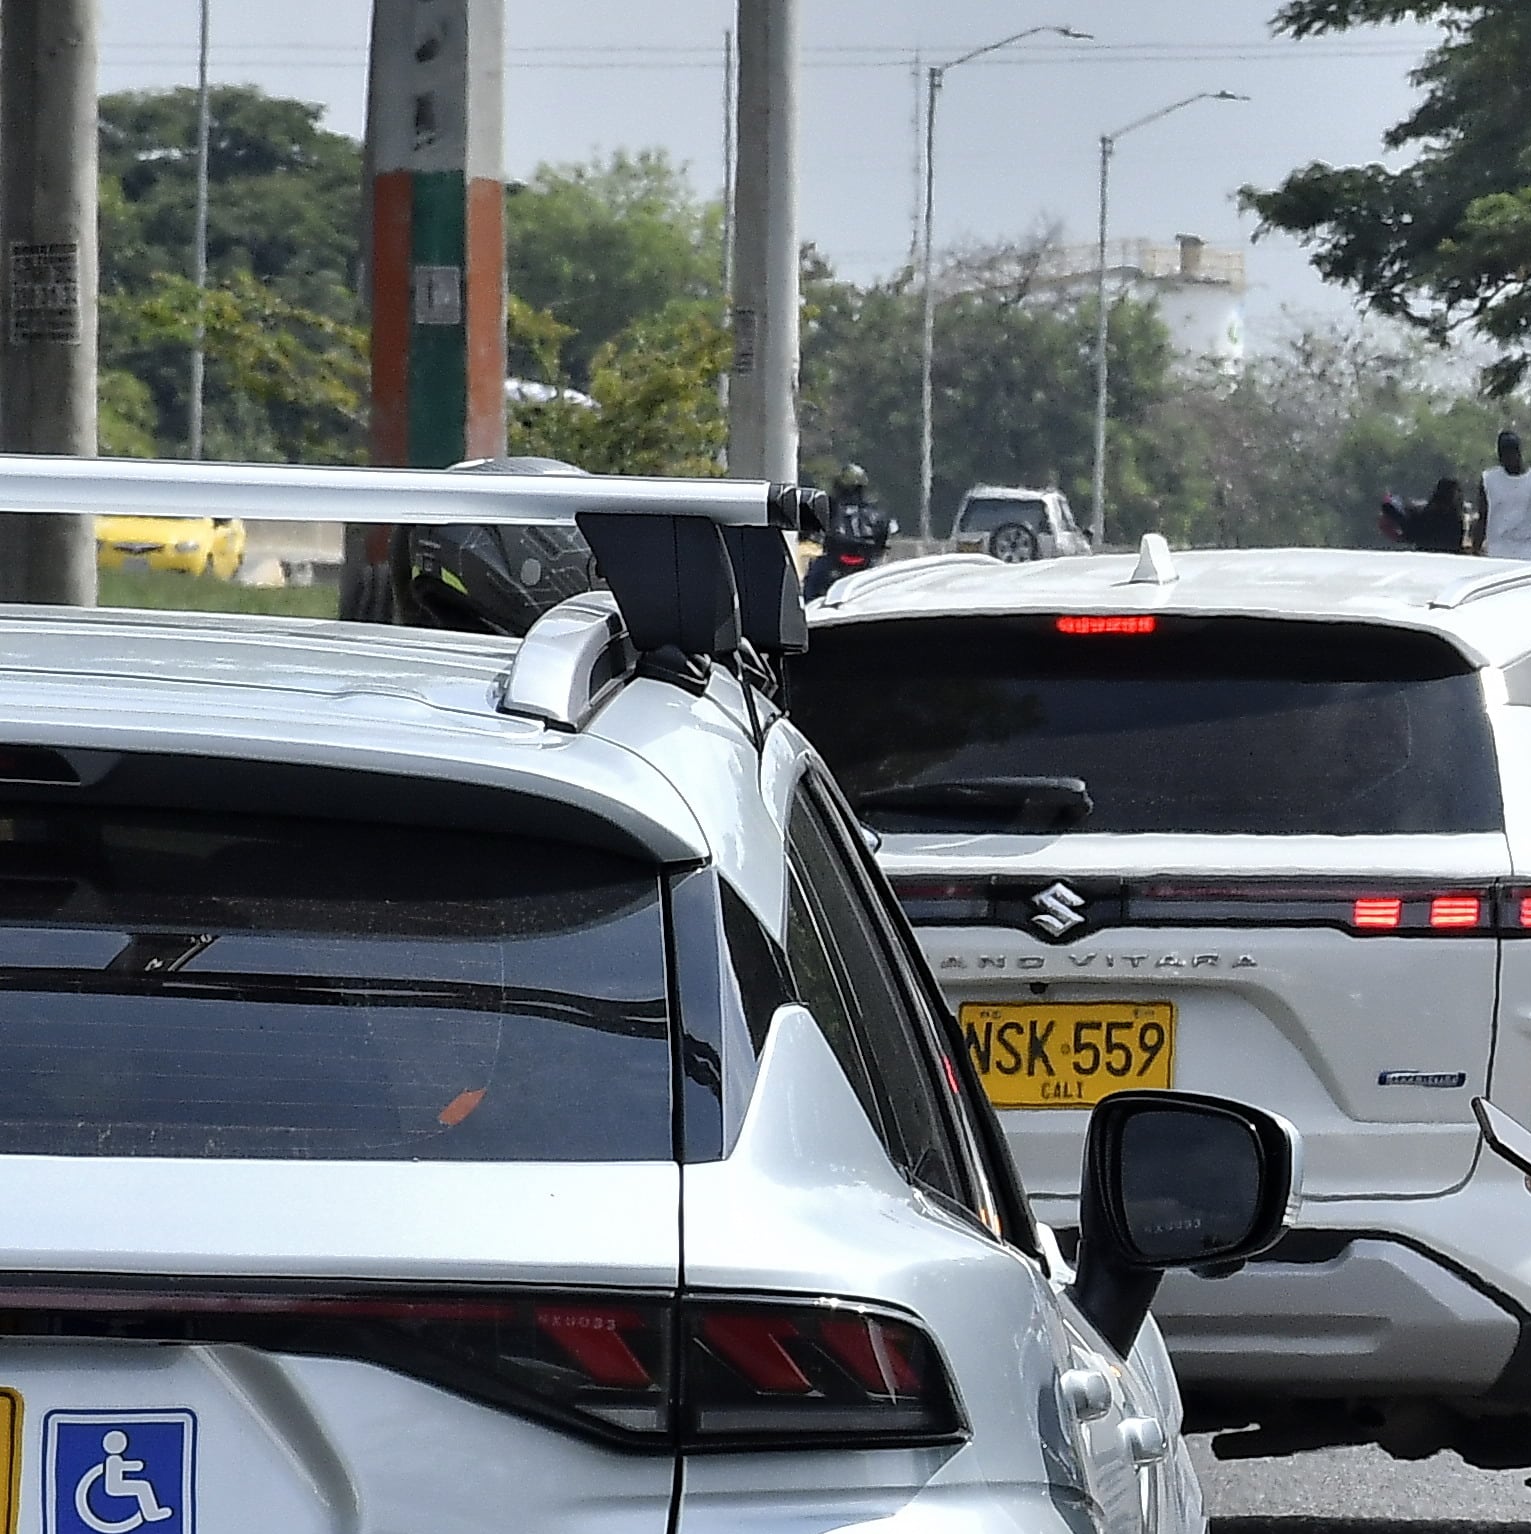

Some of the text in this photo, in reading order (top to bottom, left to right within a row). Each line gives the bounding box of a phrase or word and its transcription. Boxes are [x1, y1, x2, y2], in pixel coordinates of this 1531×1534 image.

[940, 952, 1258, 970] AND VITARA
[1072, 1020, 1165, 1077] 559
[1040, 1081, 1083, 1100] CALI
